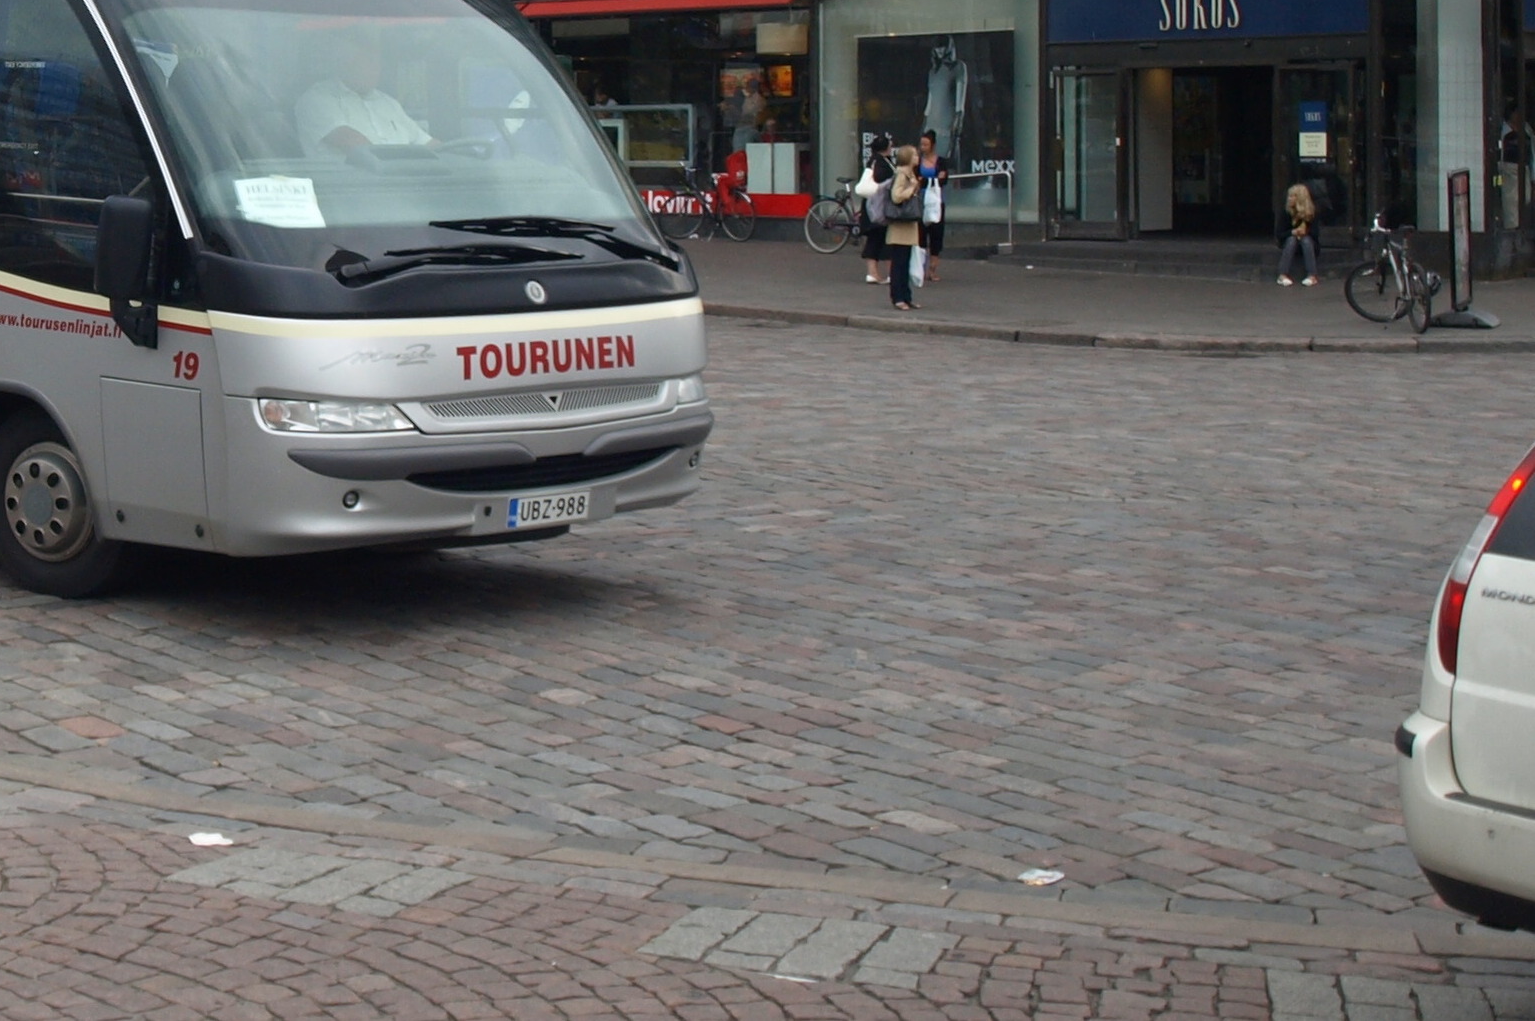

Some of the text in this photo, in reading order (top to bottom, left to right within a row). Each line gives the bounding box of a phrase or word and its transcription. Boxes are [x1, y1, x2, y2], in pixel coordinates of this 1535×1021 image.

[173, 351, 199, 380] 19
[456, 335, 636, 380] TOURUNEN
[520, 496, 585, 521] UBZ-988
